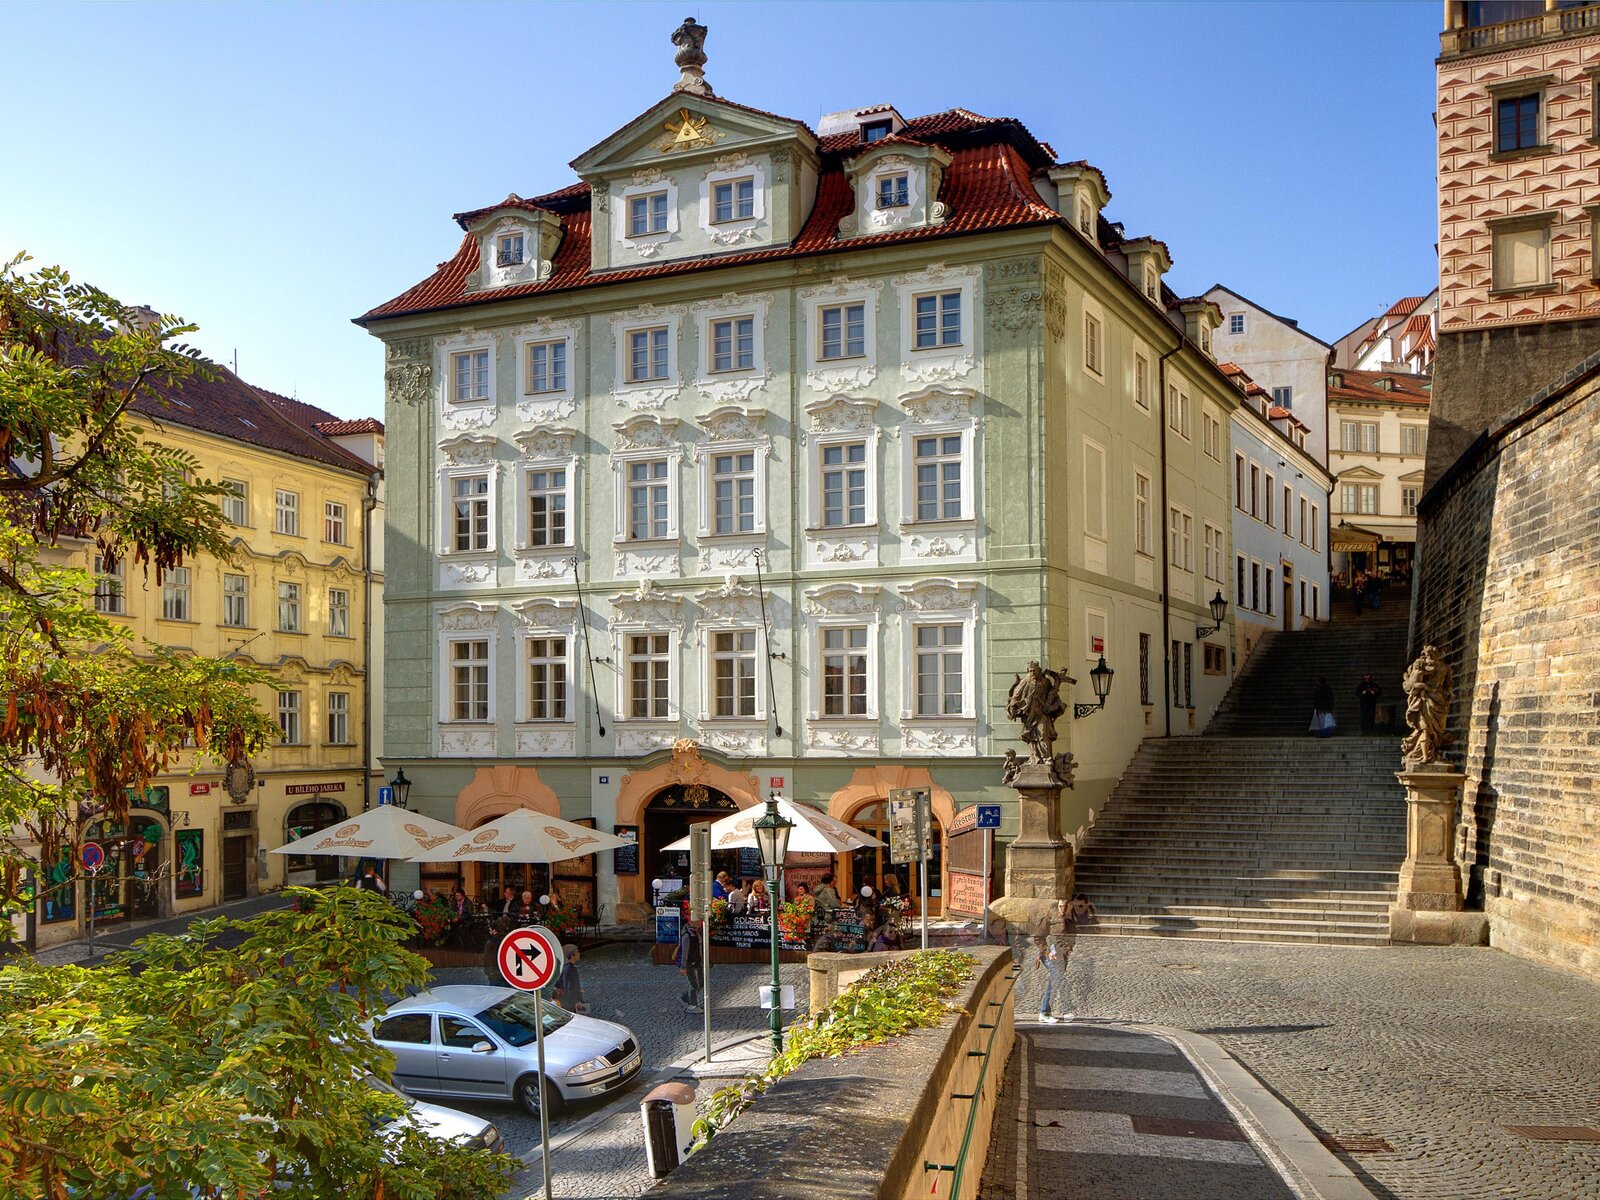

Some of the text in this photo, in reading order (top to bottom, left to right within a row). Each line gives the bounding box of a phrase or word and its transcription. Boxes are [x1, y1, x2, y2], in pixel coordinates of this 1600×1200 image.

[1336, 543, 1374, 551] PIZZERIA
[288, 786, 294, 794] U
[320, 784, 343, 792] JABLKA
[954, 812, 976, 828] Restau
[718, 832, 755, 846] Pilsner
[452, 842, 516, 857] Pilsner Urquell
[734, 916, 764, 924] GOLDEN
[836, 911, 860, 919] SPECIAL
